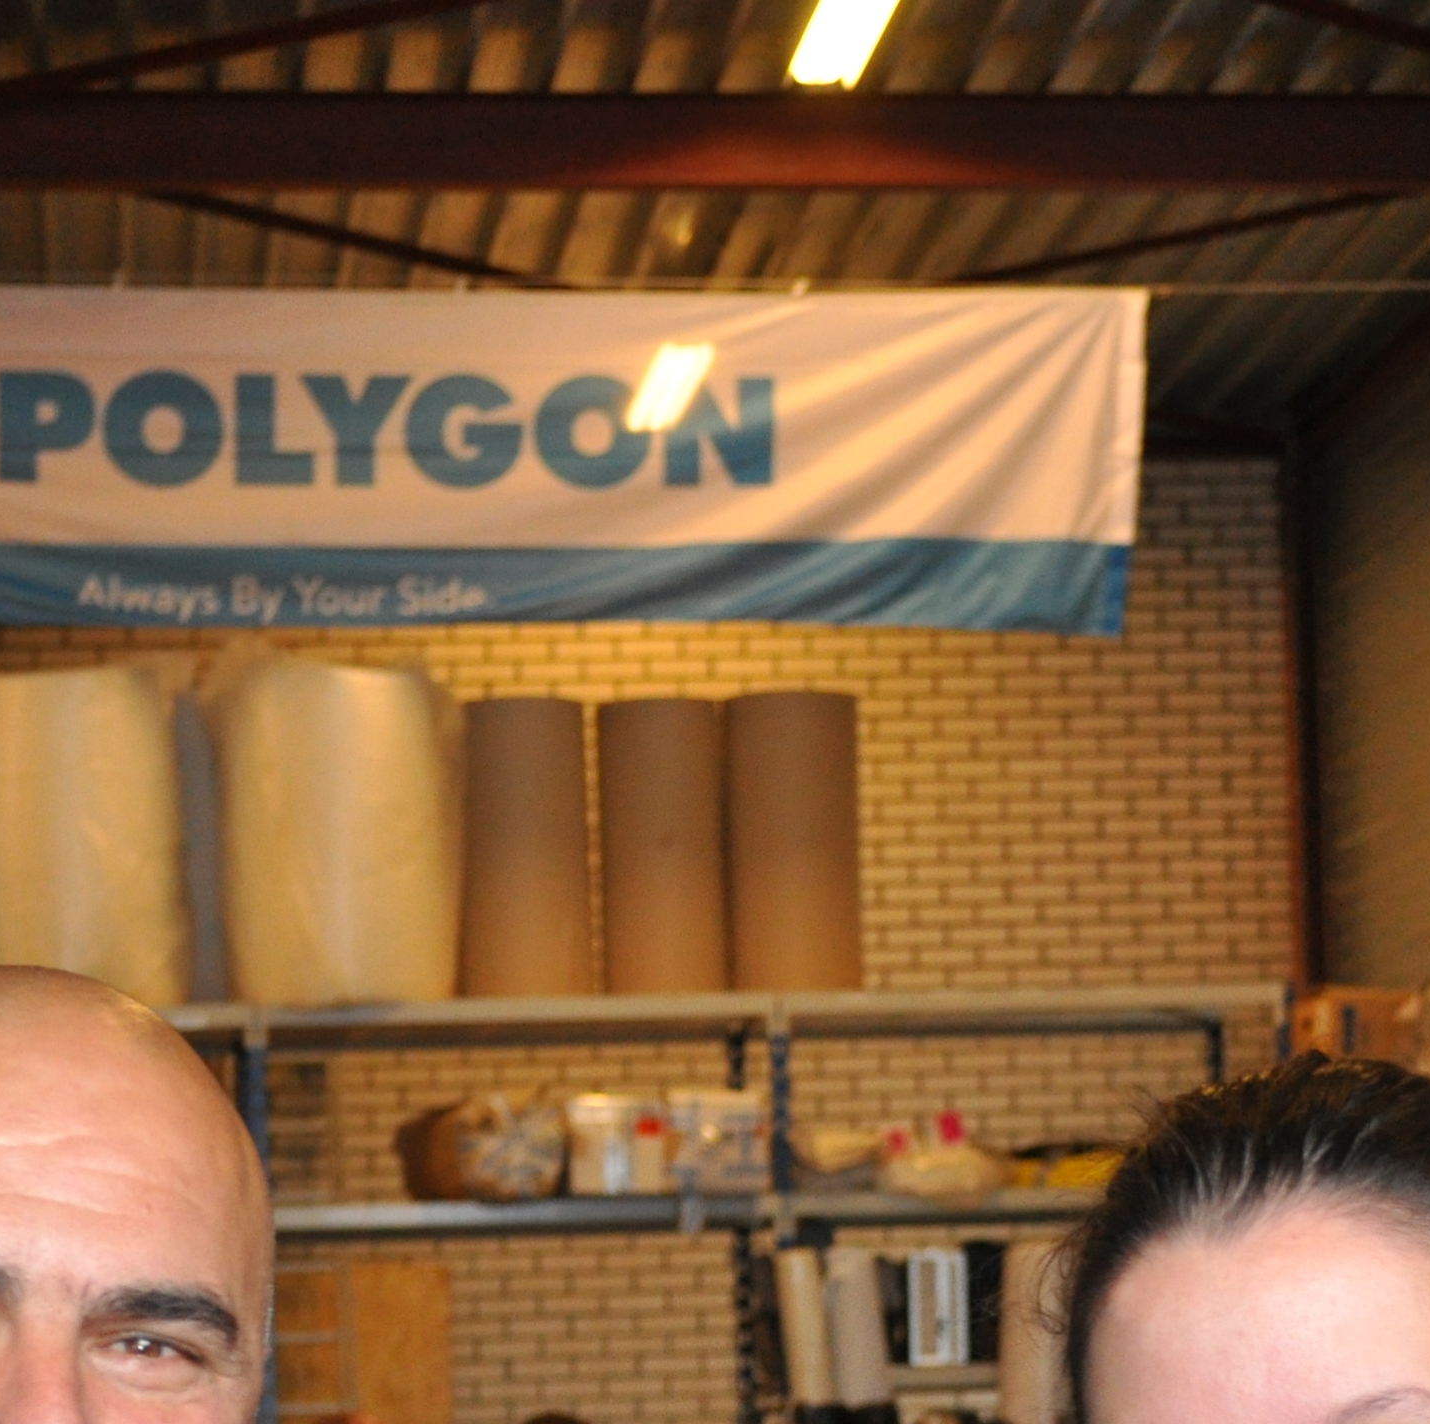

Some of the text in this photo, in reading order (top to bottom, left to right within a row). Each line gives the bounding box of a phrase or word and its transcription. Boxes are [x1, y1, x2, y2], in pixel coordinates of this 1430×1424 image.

[79, 574, 488, 625] Always By Your Side
